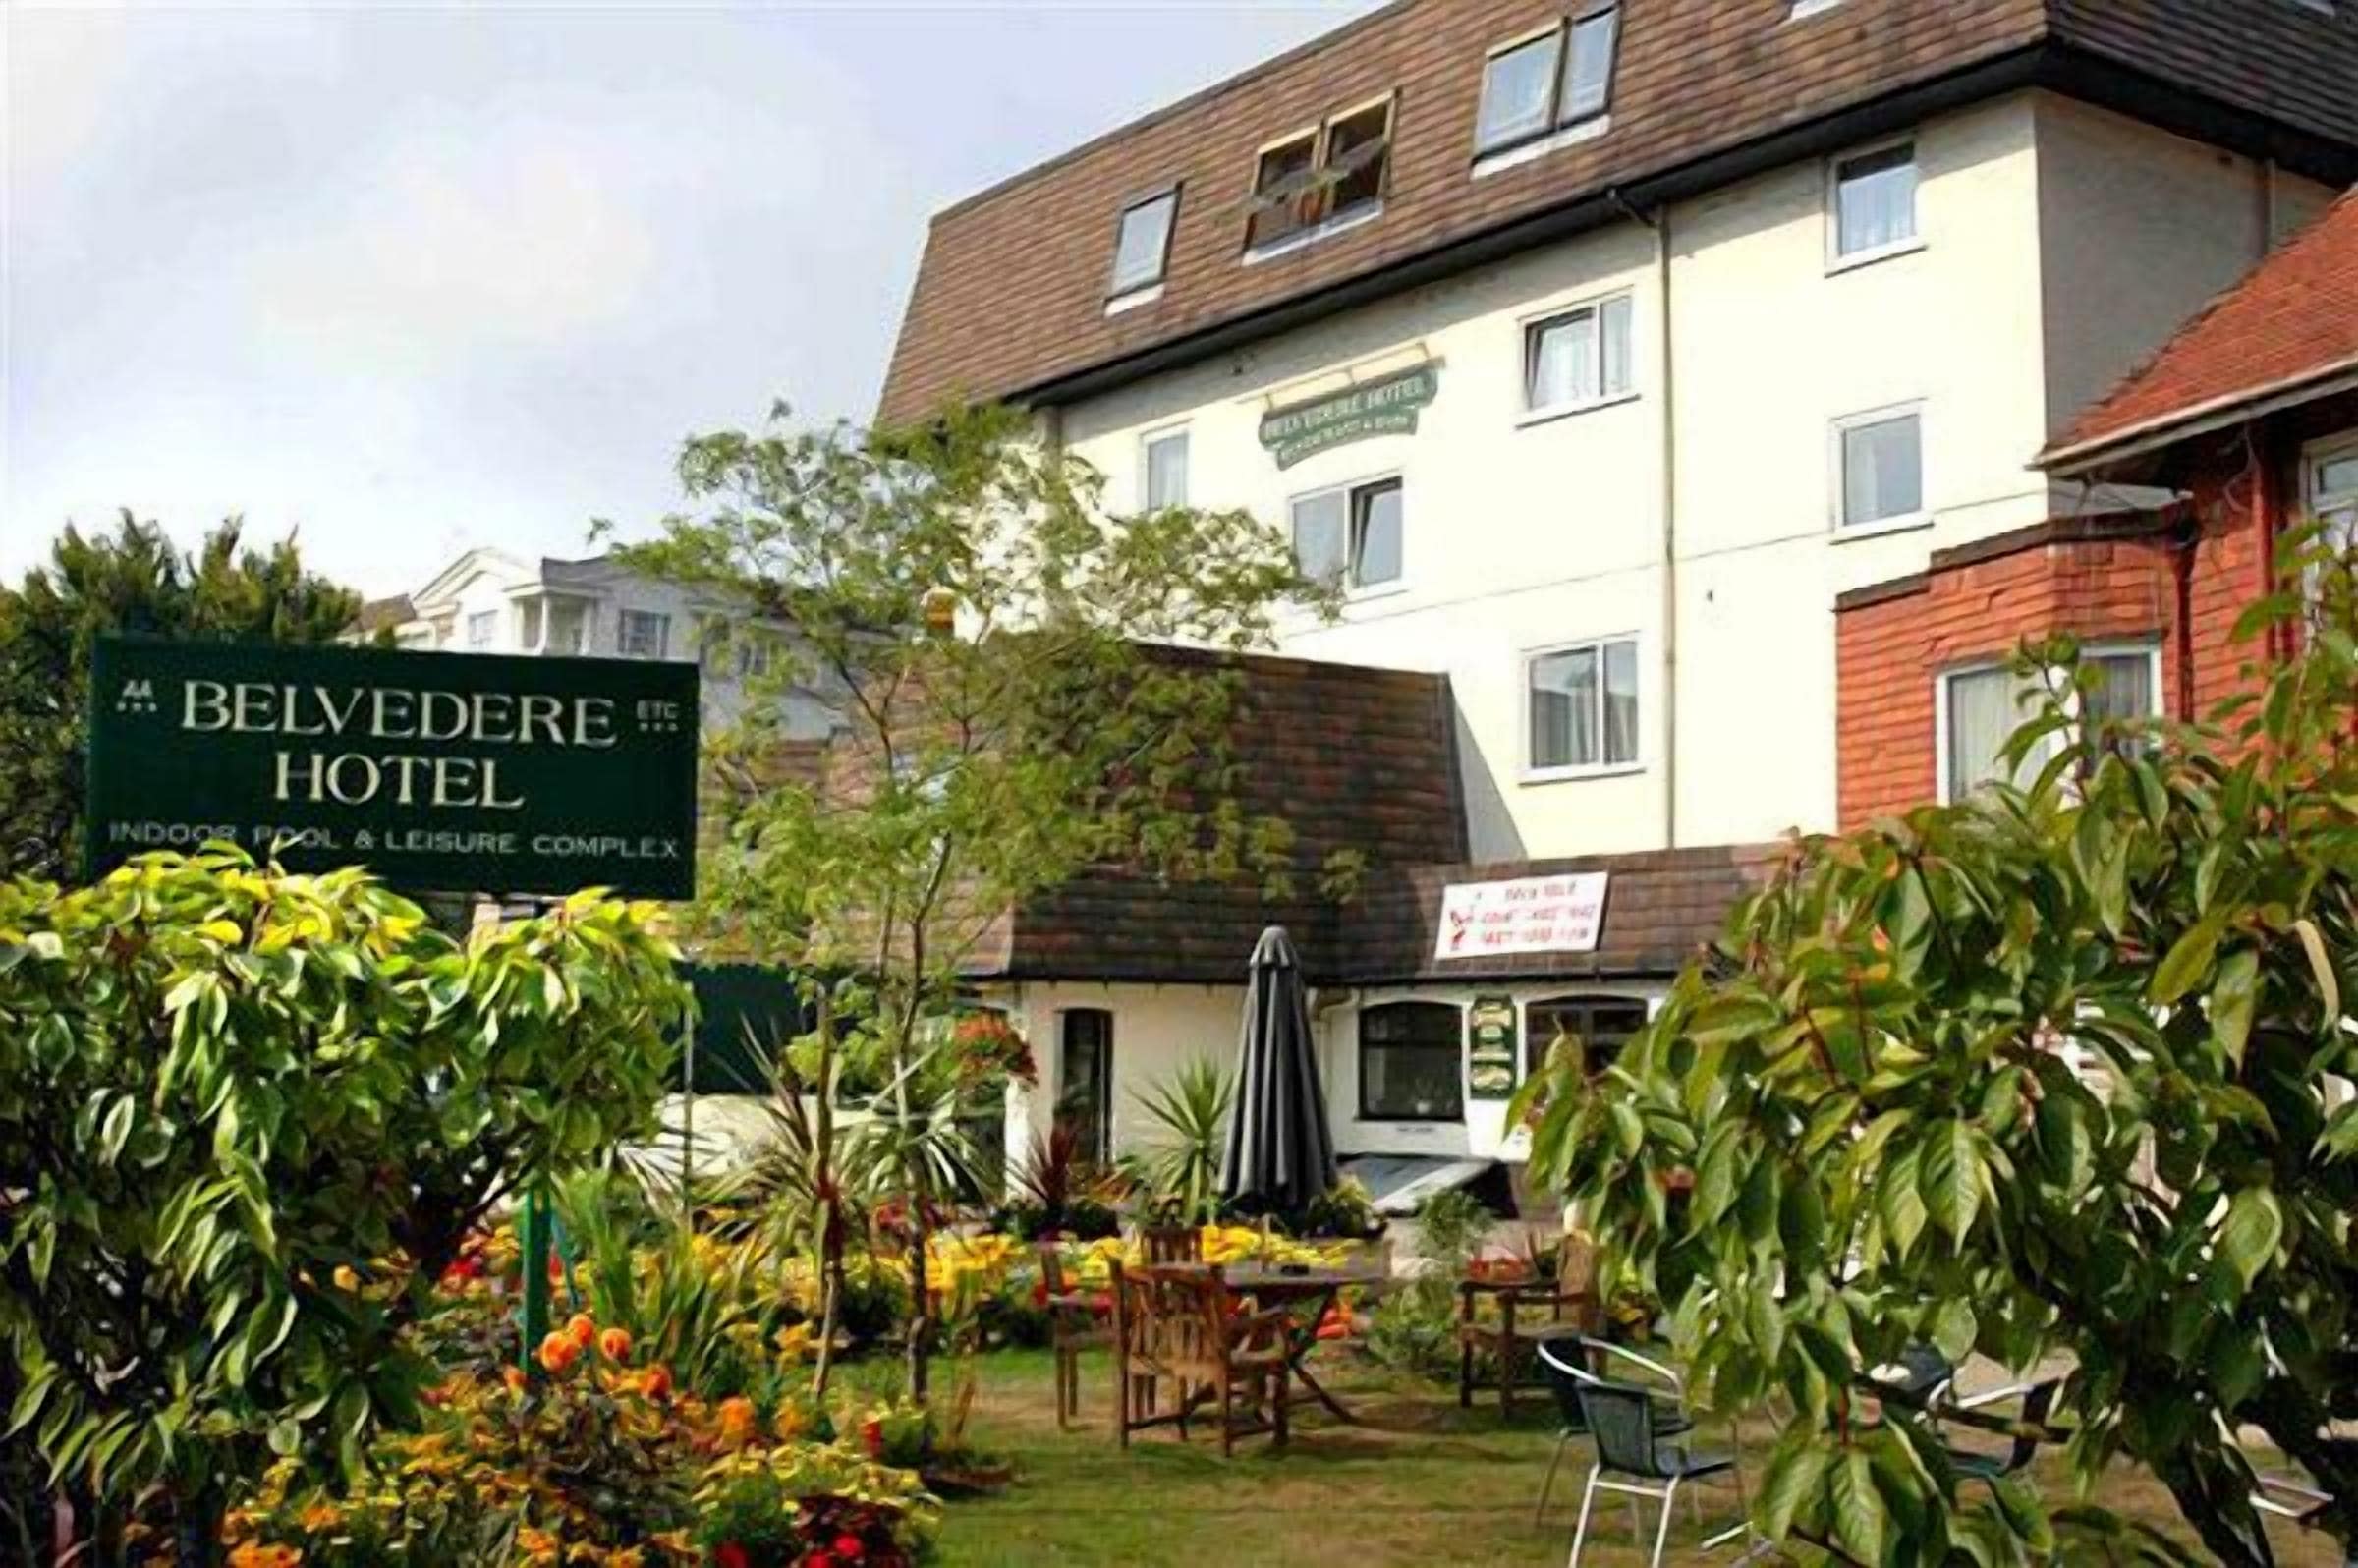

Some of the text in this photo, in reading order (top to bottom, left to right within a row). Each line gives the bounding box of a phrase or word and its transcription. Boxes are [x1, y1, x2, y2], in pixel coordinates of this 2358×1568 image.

[181, 680, 617, 748] BELVEDERE
[275, 751, 526, 810] HOTEL
[108, 820, 679, 859] INDOOR POOL & LEISURE COMPLEX
